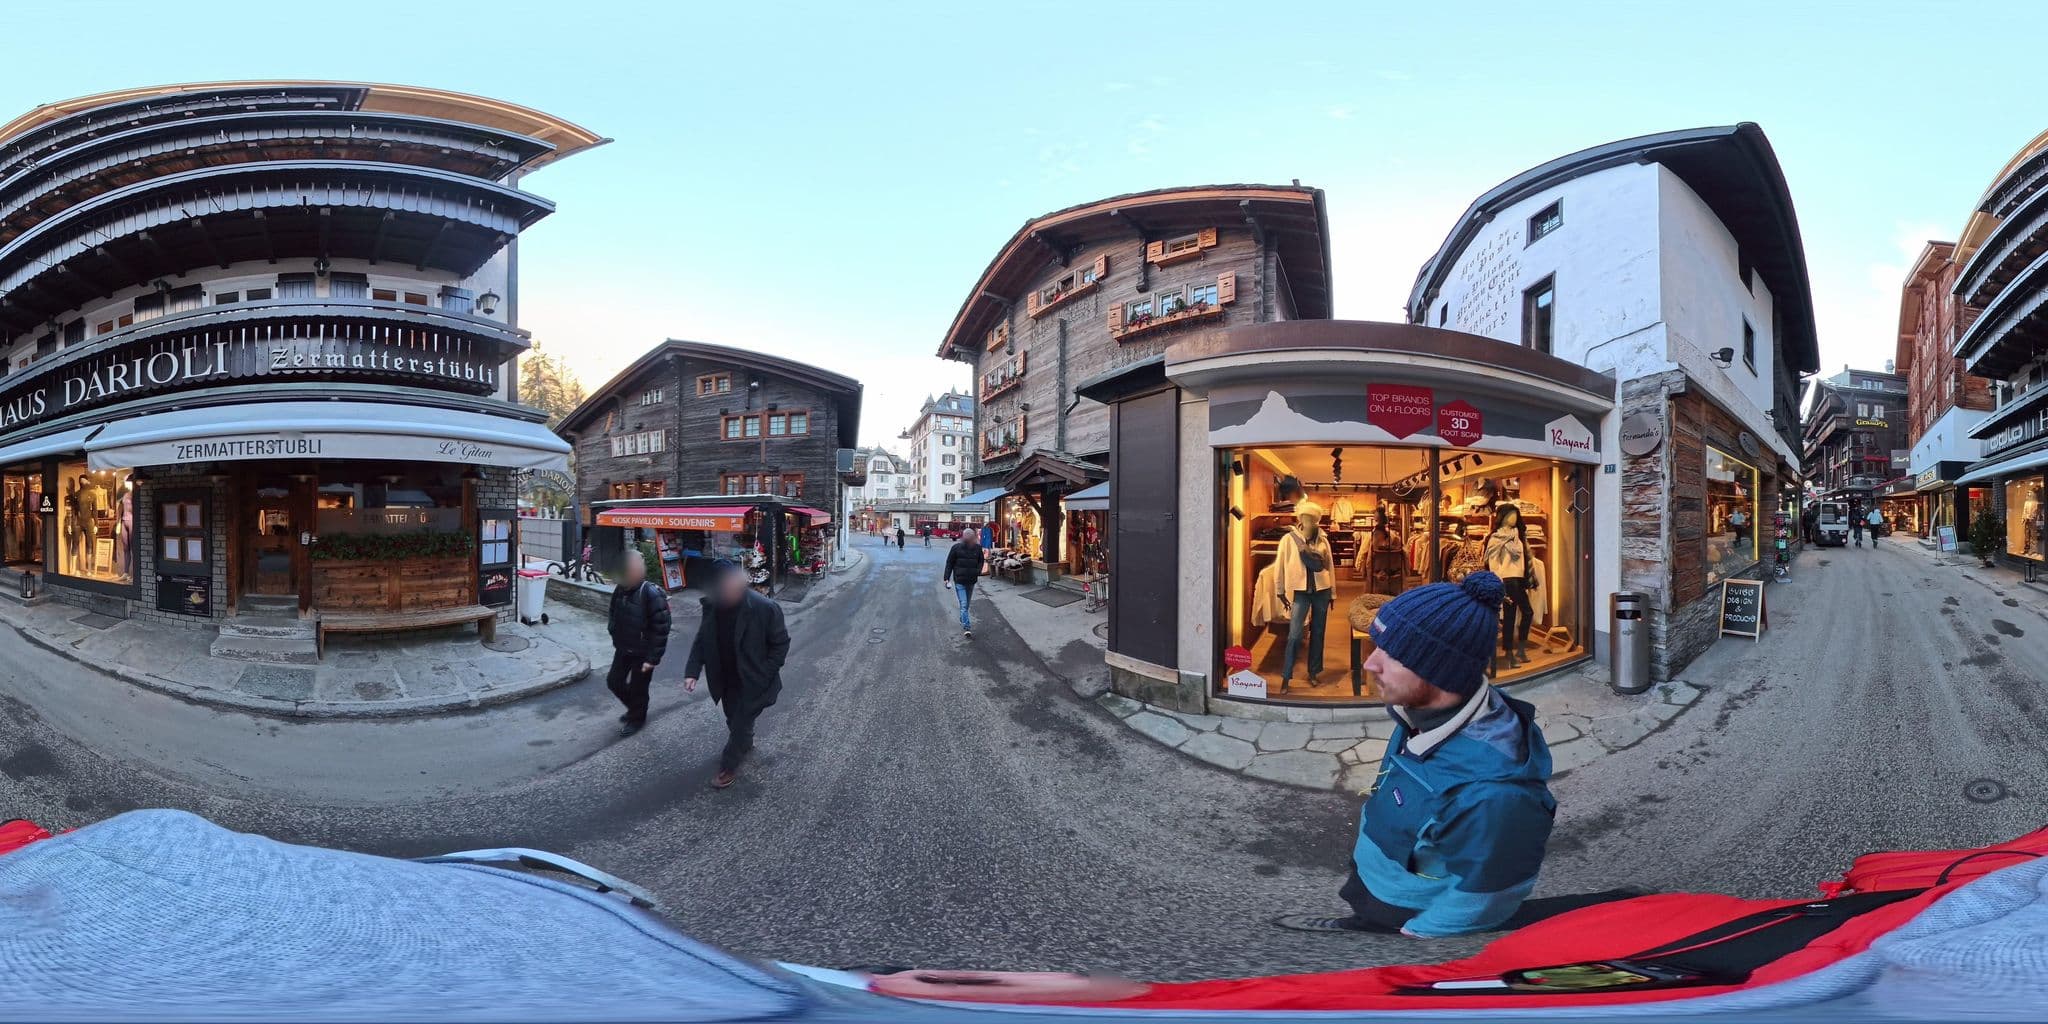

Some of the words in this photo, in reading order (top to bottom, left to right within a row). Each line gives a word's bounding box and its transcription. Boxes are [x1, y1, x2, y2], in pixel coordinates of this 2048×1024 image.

[271, 348, 494, 384] Zermatterstübli
[64, 341, 228, 407] DARIOLI
[1371, 393, 1390, 402] TOP
[1392, 394, 1430, 405] BRANDS
[1370, 404, 1385, 413] ON
[1386, 405, 1393, 413] 4
[1394, 406, 1431, 416] FLOORS
[1440, 409, 1479, 420] CUSTOMIZE
[1451, 417, 1469, 430] 3D
[1461, 431, 1479, 439] SCAN
[1622, 427, 1660, 442] Fernanda's
[1550, 428, 1591, 454] Bayard
[436, 440, 455, 456] Le
[460, 443, 494, 460] Gitan
[632, 518, 664, 526] PAVILLON
[669, 518, 715, 528] SOUVENIRS
[1231, 677, 1263, 689] Bayard
